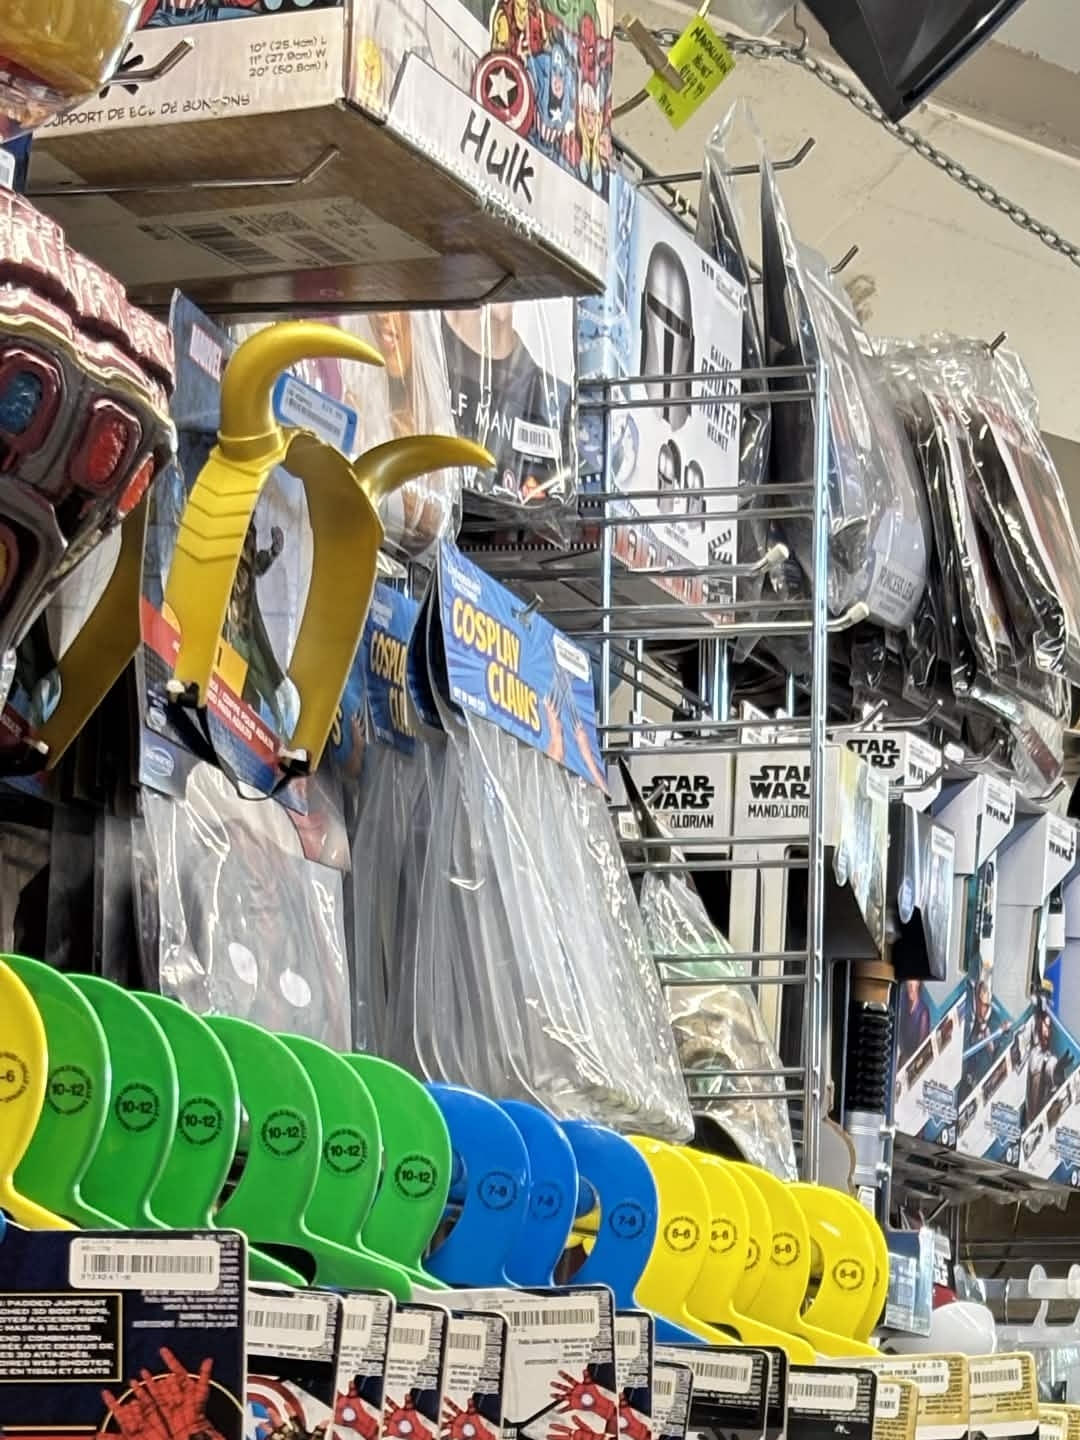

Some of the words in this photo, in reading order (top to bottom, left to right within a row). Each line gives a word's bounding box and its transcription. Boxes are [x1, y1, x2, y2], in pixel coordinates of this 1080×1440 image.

[107, 106, 126, 121] DE
[460, 108, 535, 205] Hulk
[474, 401, 514, 442] MAN
[451, 596, 521, 673] COSPLAY
[370, 630, 408, 685] COSPLA
[487, 662, 542, 733] CLAWS
[845, 738, 901, 755] STAR
[862, 752, 901, 770] ARS
[641, 775, 715, 794] STAR
[749, 781, 811, 800] WAR
[647, 791, 715, 811] WARS
[747, 803, 810, 819] MANDALORI
[669, 813, 714, 830] ALORIAN
[51, 1082, 85, 1097] 10-12
[121, 1100, 154, 1115] 10-12
[184, 1114, 216, 1128] 10-12
[267, 1125, 300, 1140] 10-12
[330, 1144, 361, 1158] 10-12
[400, 1168, 432, 1184] 10-12
[46, 1324, 92, 1332] GLOVES
[73, 1367, 111, 1376] GANTS
